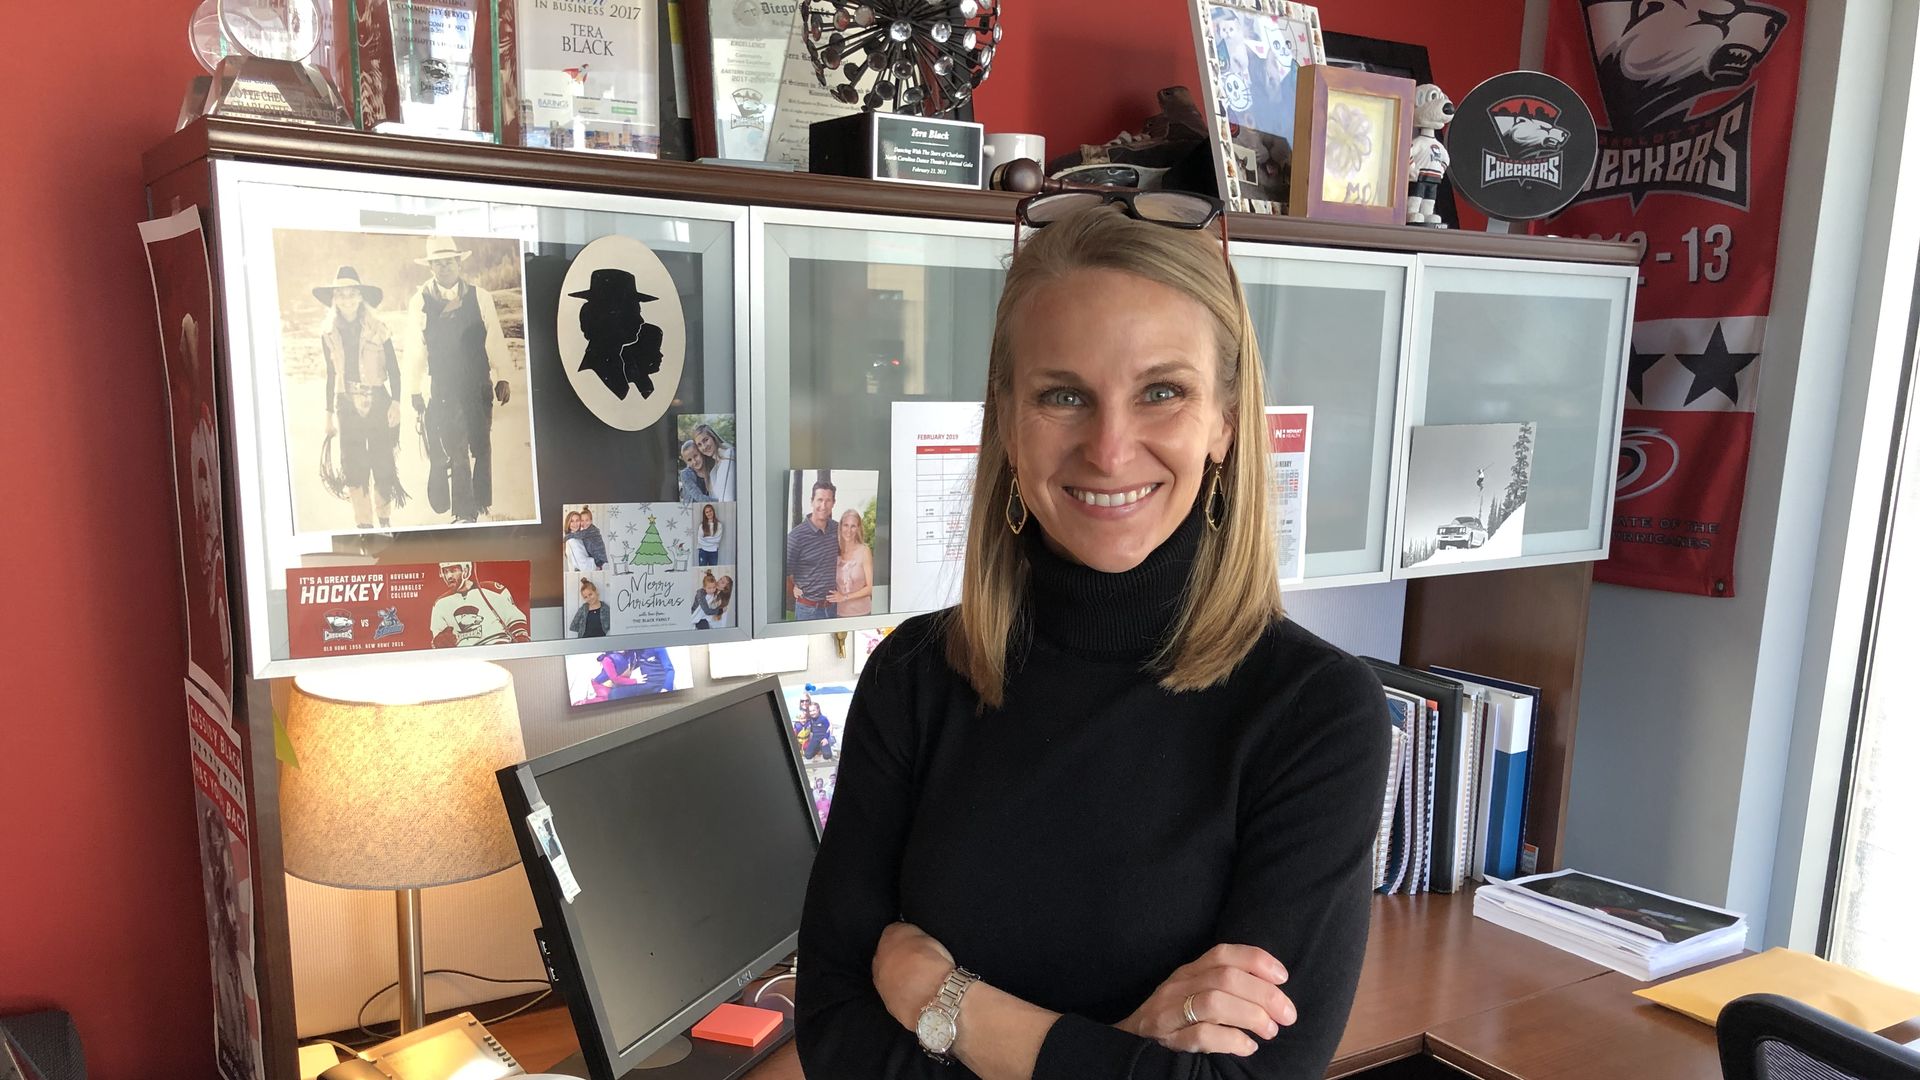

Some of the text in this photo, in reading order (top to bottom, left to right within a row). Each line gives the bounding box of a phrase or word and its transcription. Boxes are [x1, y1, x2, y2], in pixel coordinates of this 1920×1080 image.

[396, 3, 443, 16] COMMUNITY
[534, 0, 641, 20] IN BUSINESS 2017
[760, 1, 796, 16] Diego
[570, 23, 603, 39] TERA
[562, 36, 615, 57] BLACK
[911, 127, 950, 140] Tera Black
[1583, 101, 1745, 192] ECKERS
[1485, 153, 1560, 184] CHECKERS
[300, 574, 384, 585] IT'S A GREAT DAY FOR
[390, 572, 419, 581] NOVEMBER
[631, 572, 675, 598] Merry
[300, 582, 385, 604] HOCKEY
[390, 591, 419, 599] COLISEUM
[617, 589, 685, 612] Christmas
[360, 619, 369, 627] VS
[225, 801, 247, 840] BACK
